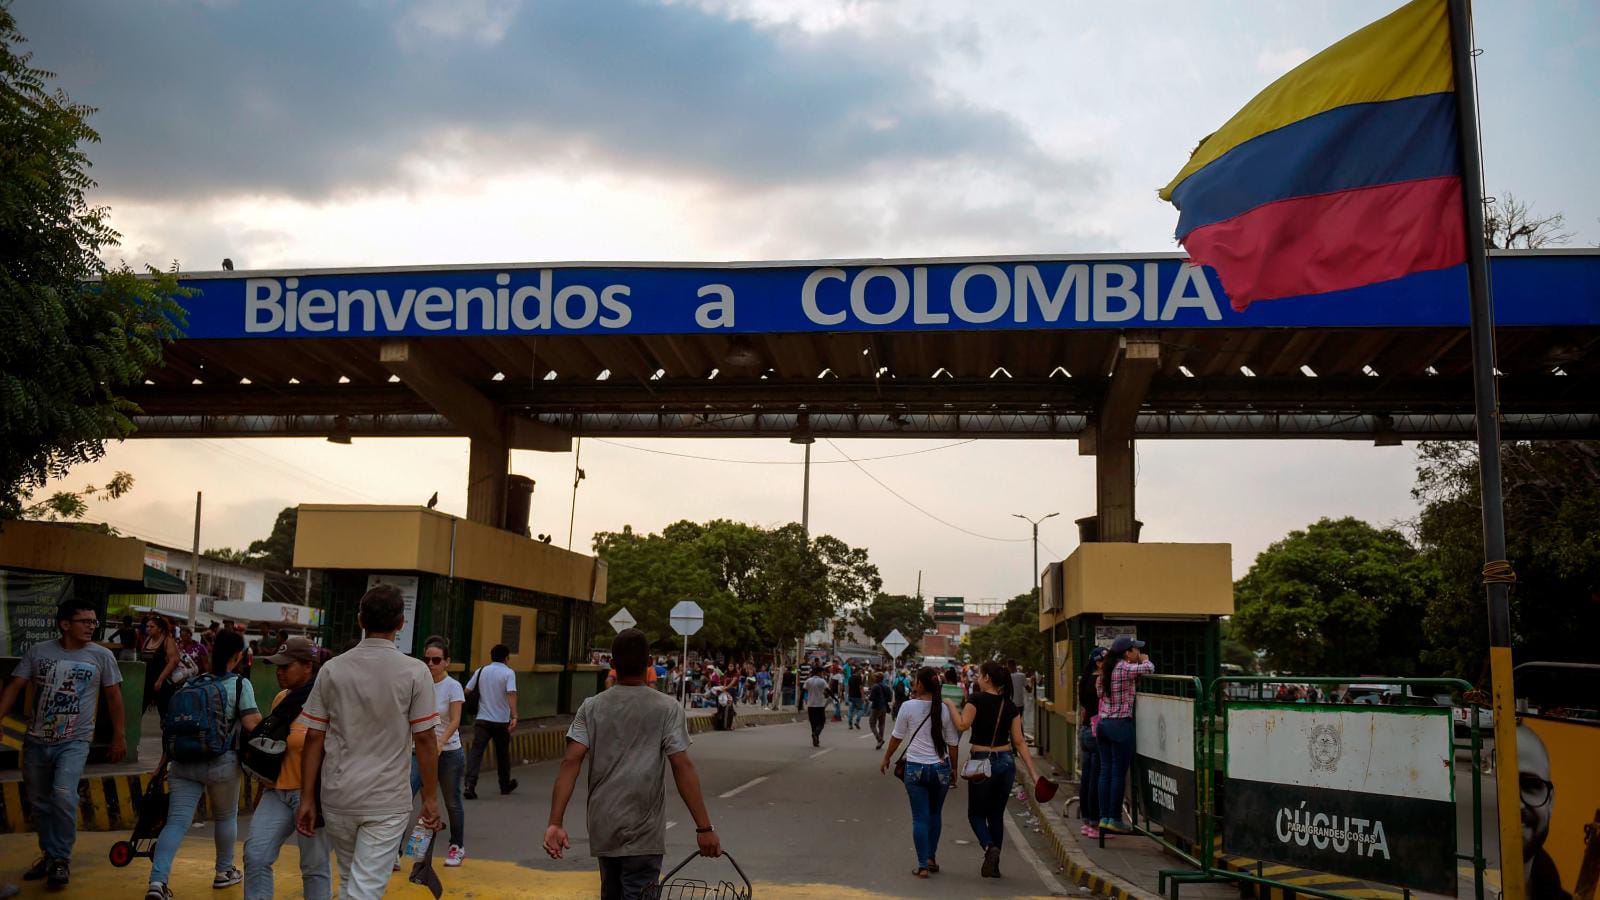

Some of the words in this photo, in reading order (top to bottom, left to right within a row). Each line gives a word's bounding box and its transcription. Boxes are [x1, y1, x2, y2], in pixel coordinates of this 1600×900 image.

[244, 268, 632, 333] Bienvenidos
[694, 283, 736, 329] a
[801, 262, 1222, 326] COLOMBIA
[1275, 800, 1391, 860] CÚCUTA
[1287, 822, 1306, 833] PARA
[1308, 825, 1345, 840] GRANDES
[1347, 831, 1376, 844] COSAS
